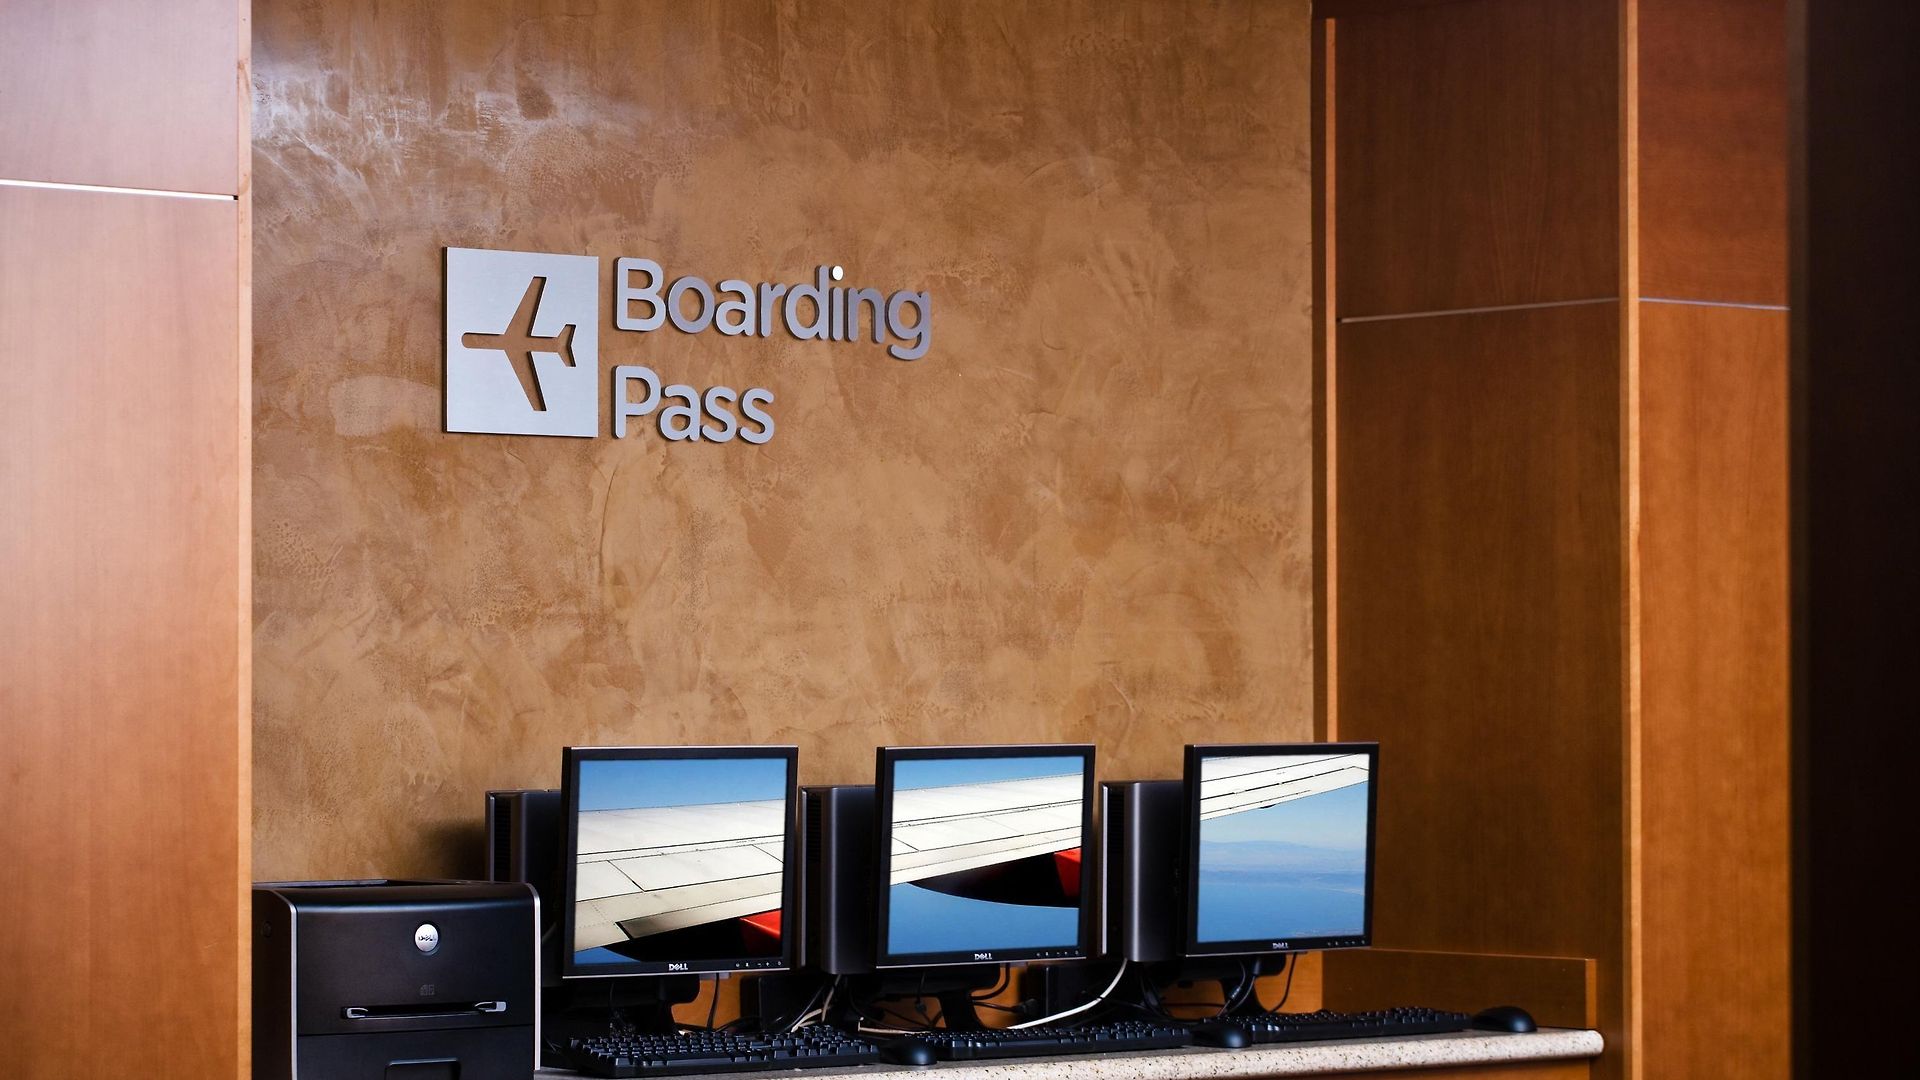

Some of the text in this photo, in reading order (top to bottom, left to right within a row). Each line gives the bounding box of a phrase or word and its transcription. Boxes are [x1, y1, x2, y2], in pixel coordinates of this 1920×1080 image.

[614, 257, 931, 360] Boarding
[612, 365, 775, 445] Pass
[668, 963, 688, 971] DELL
